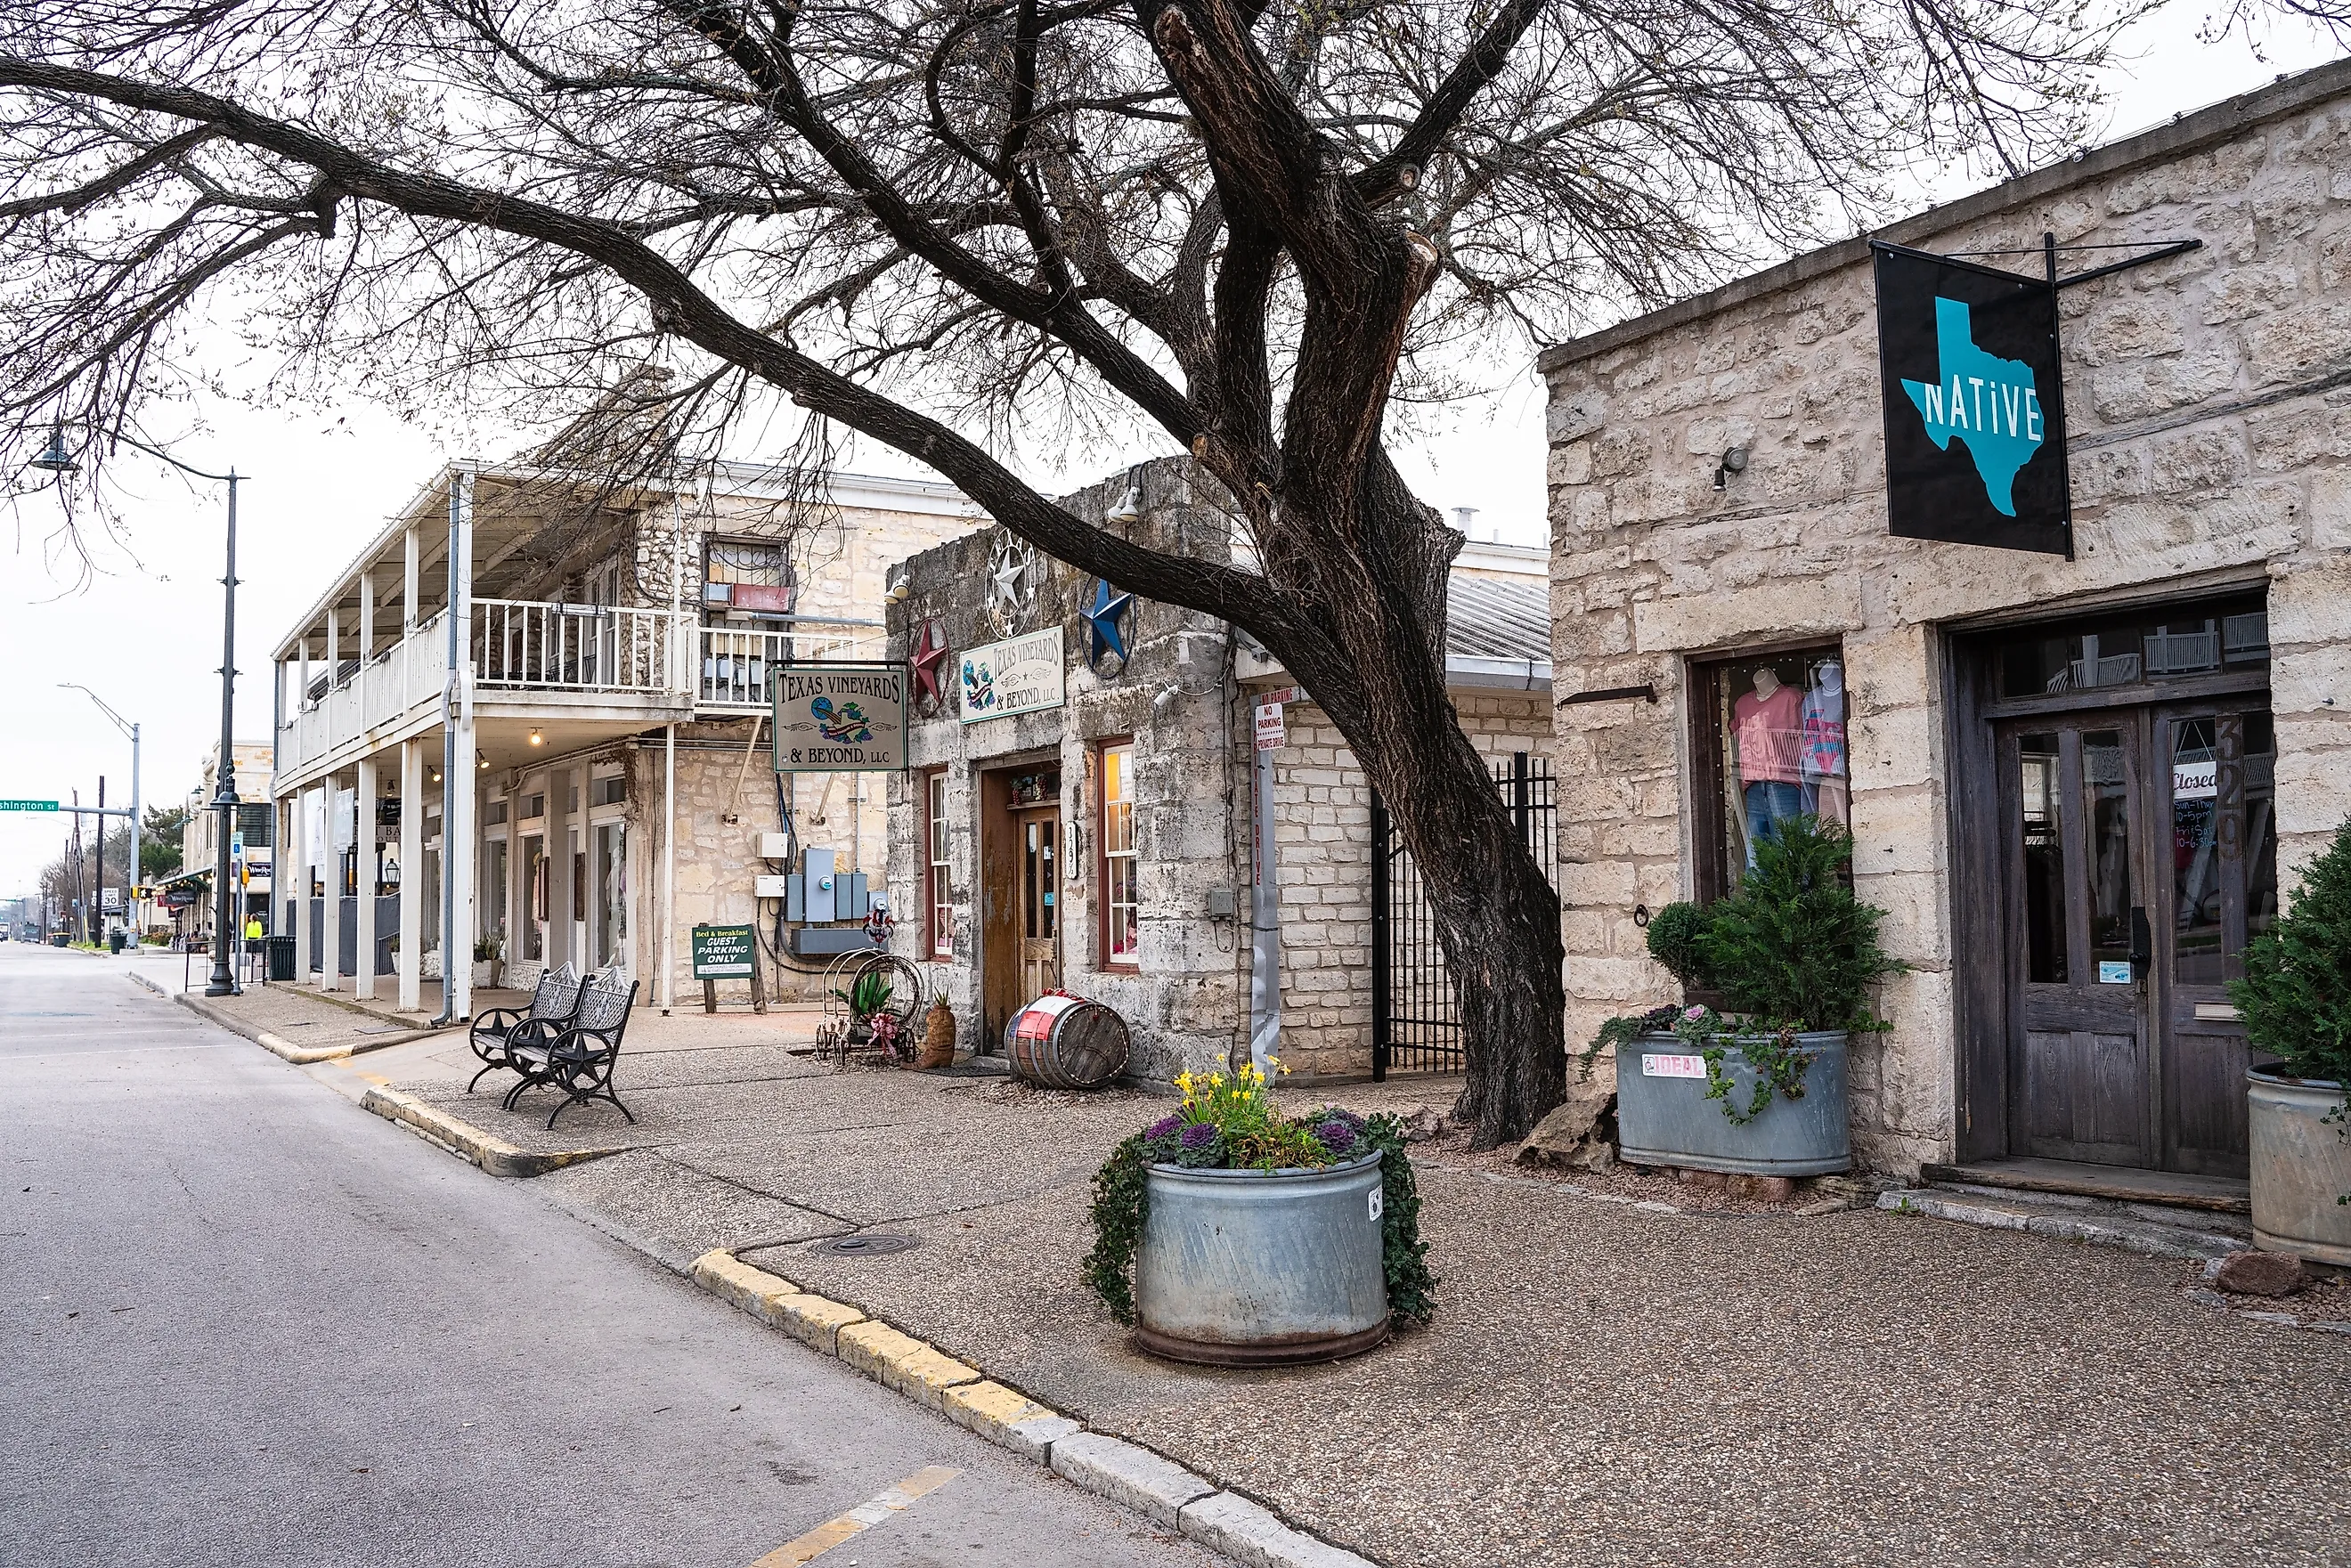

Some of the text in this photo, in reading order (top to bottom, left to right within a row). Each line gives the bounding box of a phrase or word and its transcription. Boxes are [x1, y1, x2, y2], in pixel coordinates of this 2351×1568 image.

[993, 632, 1059, 680] TEXAS VINEYARDS
[778, 673, 900, 704] TEXAS VINEYARDS
[1271, 687, 1293, 703] PARKING
[997, 695, 1004, 711] &
[1006, 687, 1041, 709] BEYOND,
[1043, 688, 1055, 702] LLC
[1264, 705, 1273, 716] NO
[1257, 716, 1281, 729] PARKING
[1257, 735, 1284, 750] PRIVATE DRIVE
[790, 747, 891, 765] & BEYOND, LLC
[104, 897, 118, 905] 30
[706, 937, 738, 946] GUEST
[697, 945, 749, 955] PARKING
[706, 955, 738, 963] ONLY
[1655, 1056, 1702, 1076] IDEAL
